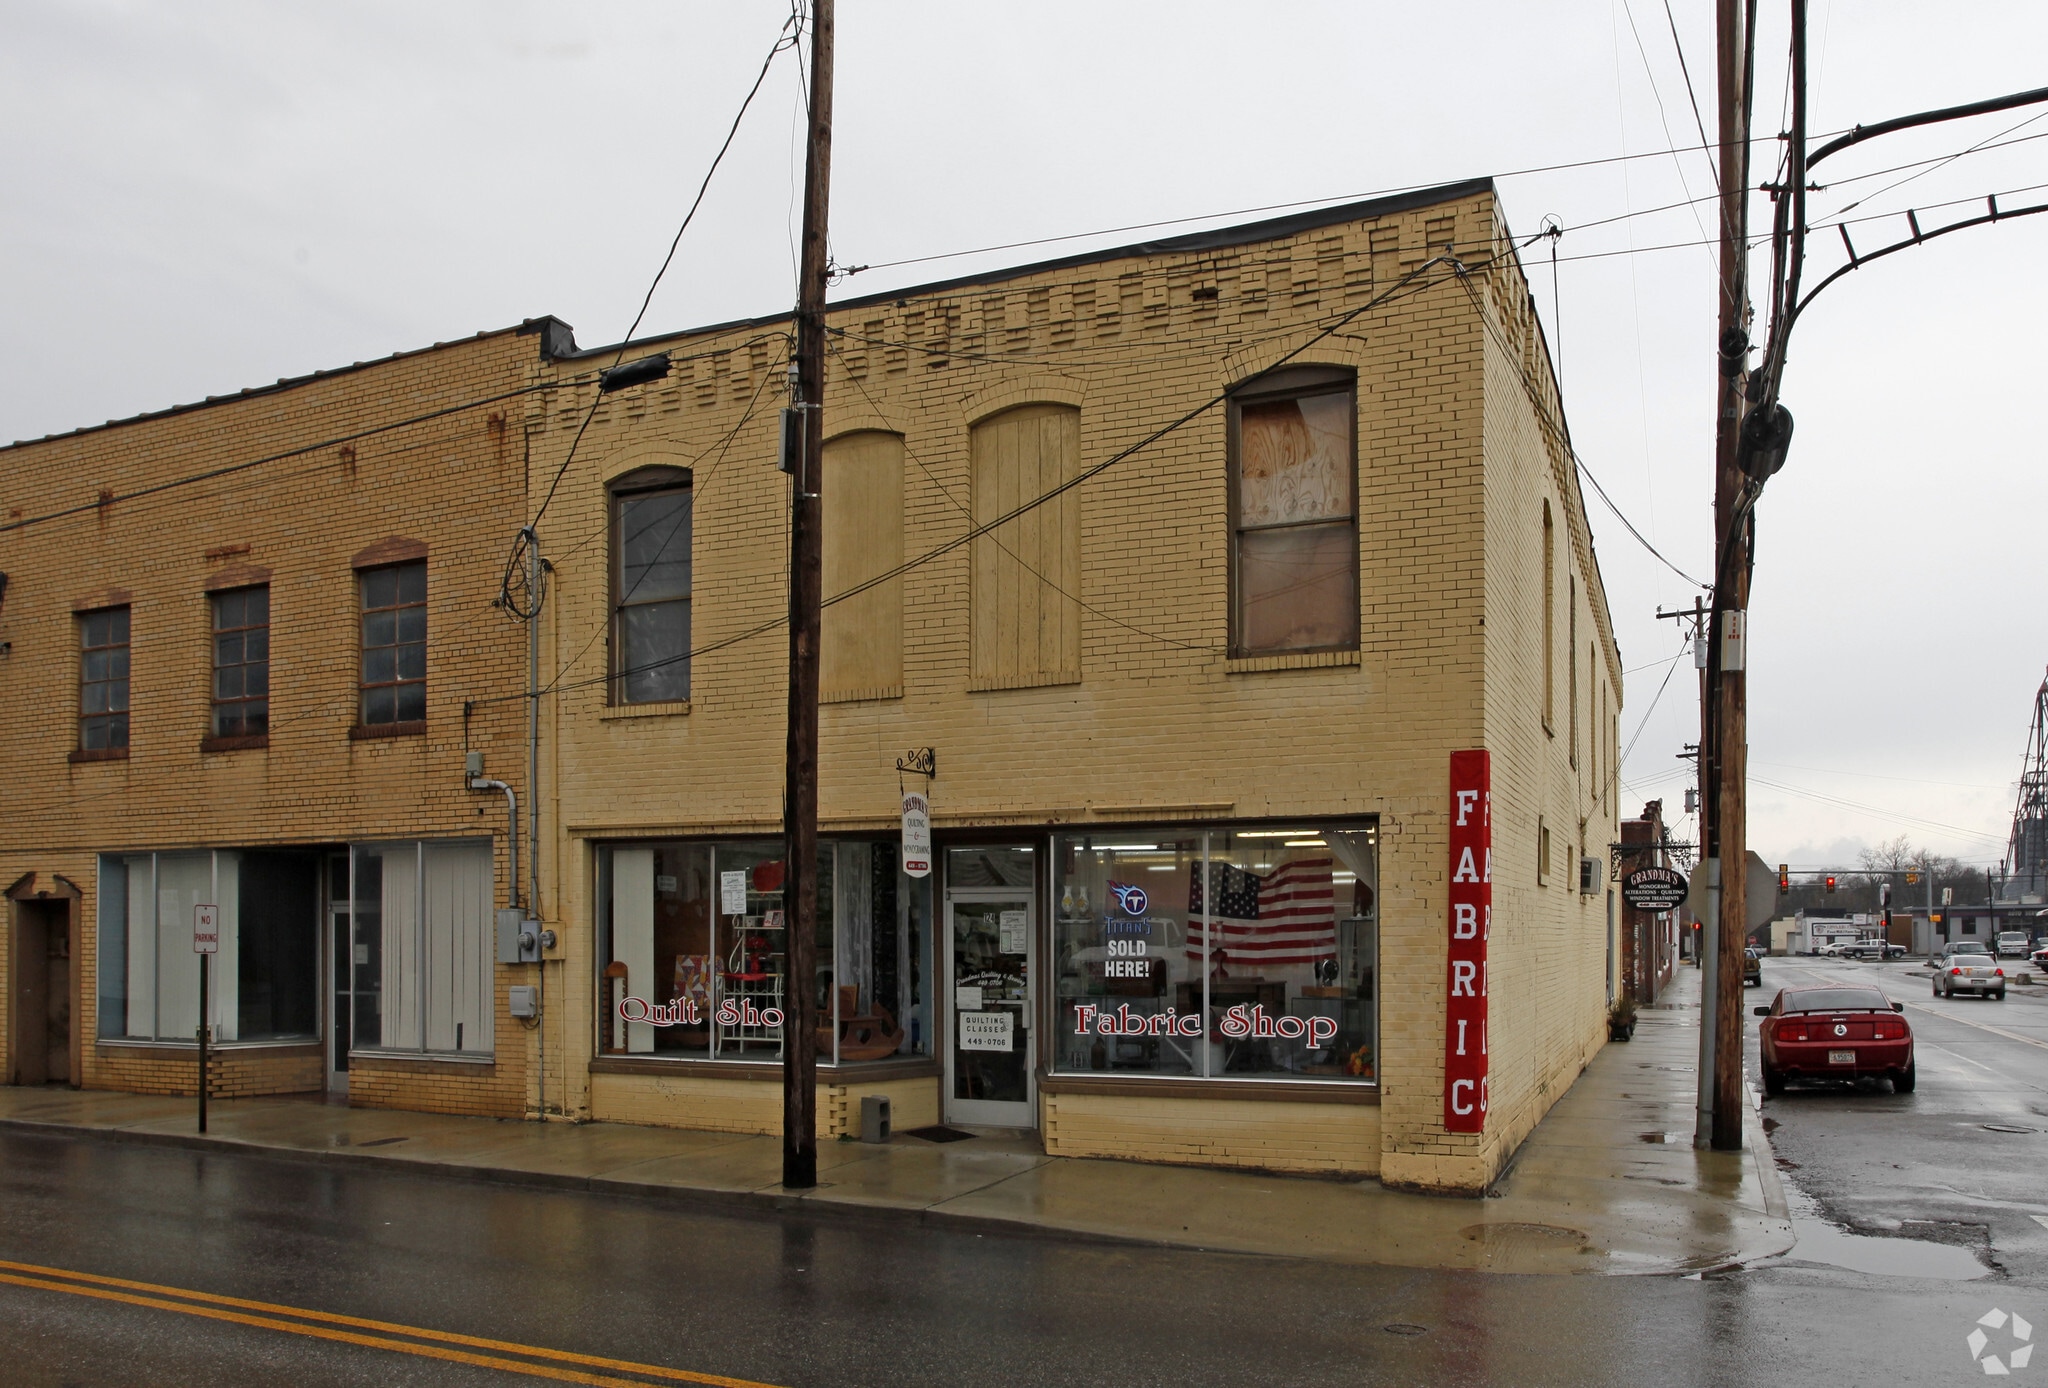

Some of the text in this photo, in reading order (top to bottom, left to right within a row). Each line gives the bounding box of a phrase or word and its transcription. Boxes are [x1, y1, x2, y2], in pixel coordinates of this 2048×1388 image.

[914, 831, 920, 840] &
[1630, 869, 1679, 885] GRANDMA'S
[201, 915, 211, 925] NO
[1103, 915, 1152, 935] TITANS
[195, 933, 217, 943] PARKING
[1108, 939, 1146, 957] SOLD
[1452, 790, 1480, 1115] FABRIC
[1104, 960, 1150, 978] HERE!
[619, 996, 784, 1027] Quilt Sho
[1074, 1003, 1338, 1049] Fabric Shop
[967, 1038, 1006, 1046] 449-0706
